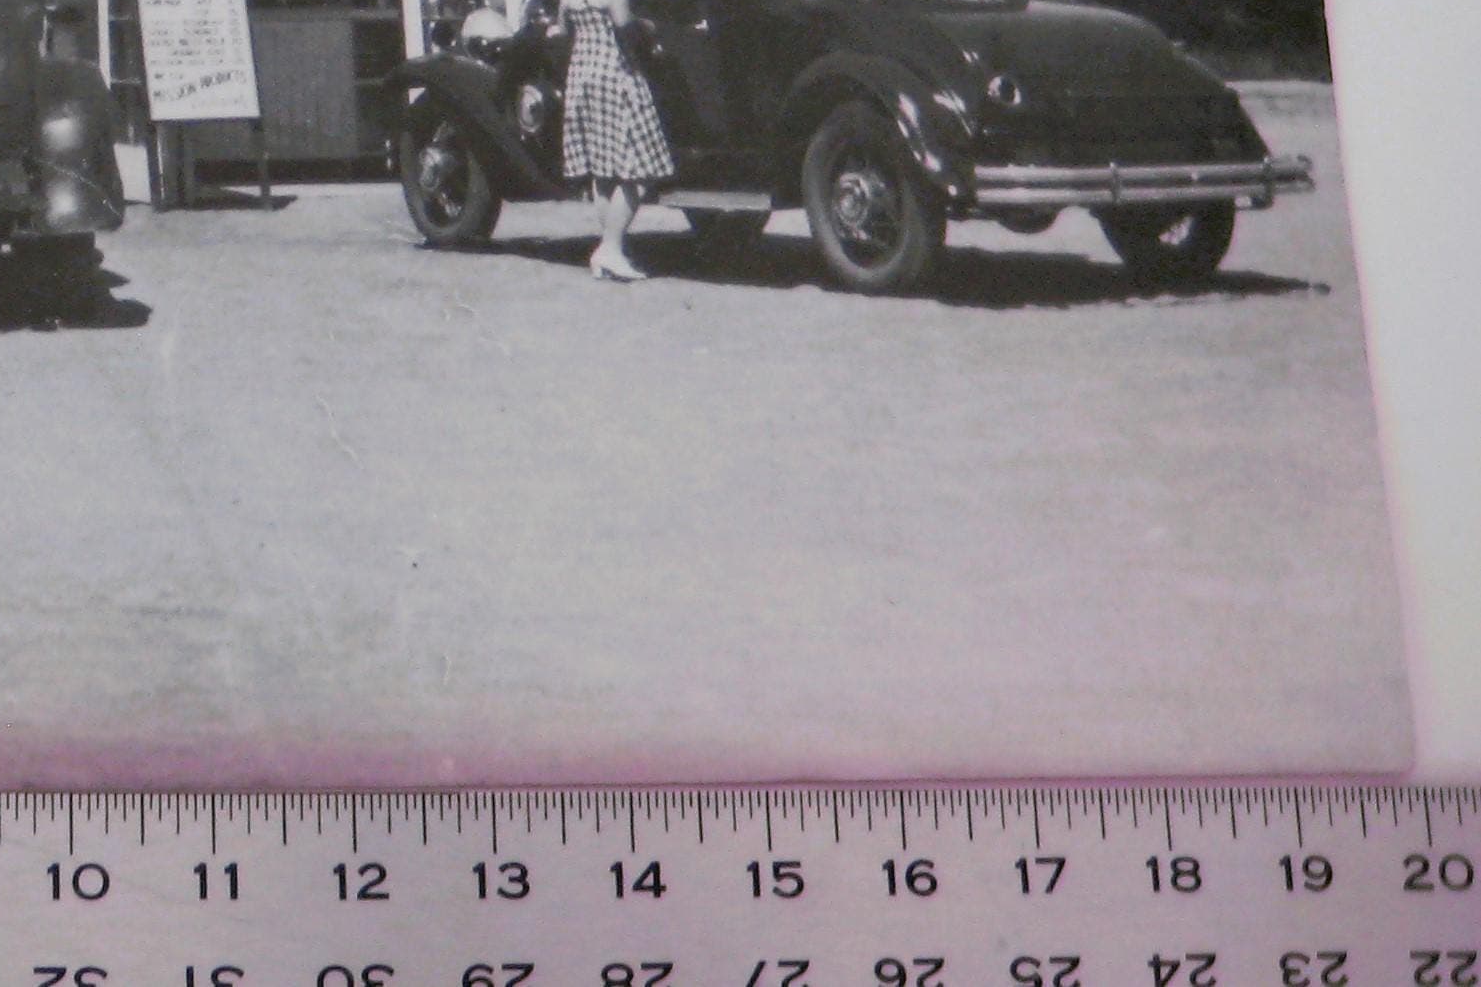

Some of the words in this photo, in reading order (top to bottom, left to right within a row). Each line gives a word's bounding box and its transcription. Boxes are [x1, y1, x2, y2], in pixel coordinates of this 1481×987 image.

[47, 863, 110, 901] 10
[194, 862, 238, 901] 11
[333, 862, 389, 901] 12
[473, 862, 530, 900] 13
[610, 861, 667, 899] 14
[747, 861, 804, 899] 15
[882, 859, 938, 897] 16
[1015, 857, 1066, 894] 17
[1146, 856, 1202, 893] 18
[1279, 855, 1333, 892] 19
[1404, 854, 1474, 892] 20
[746, 960, 810, 987] 27
[874, 958, 944, 987] 26
[1010, 956, 1080, 987] 25
[1148, 953, 1216, 987] 24
[1280, 951, 1348, 987] 23
[1411, 951, 1477, 987] 22
